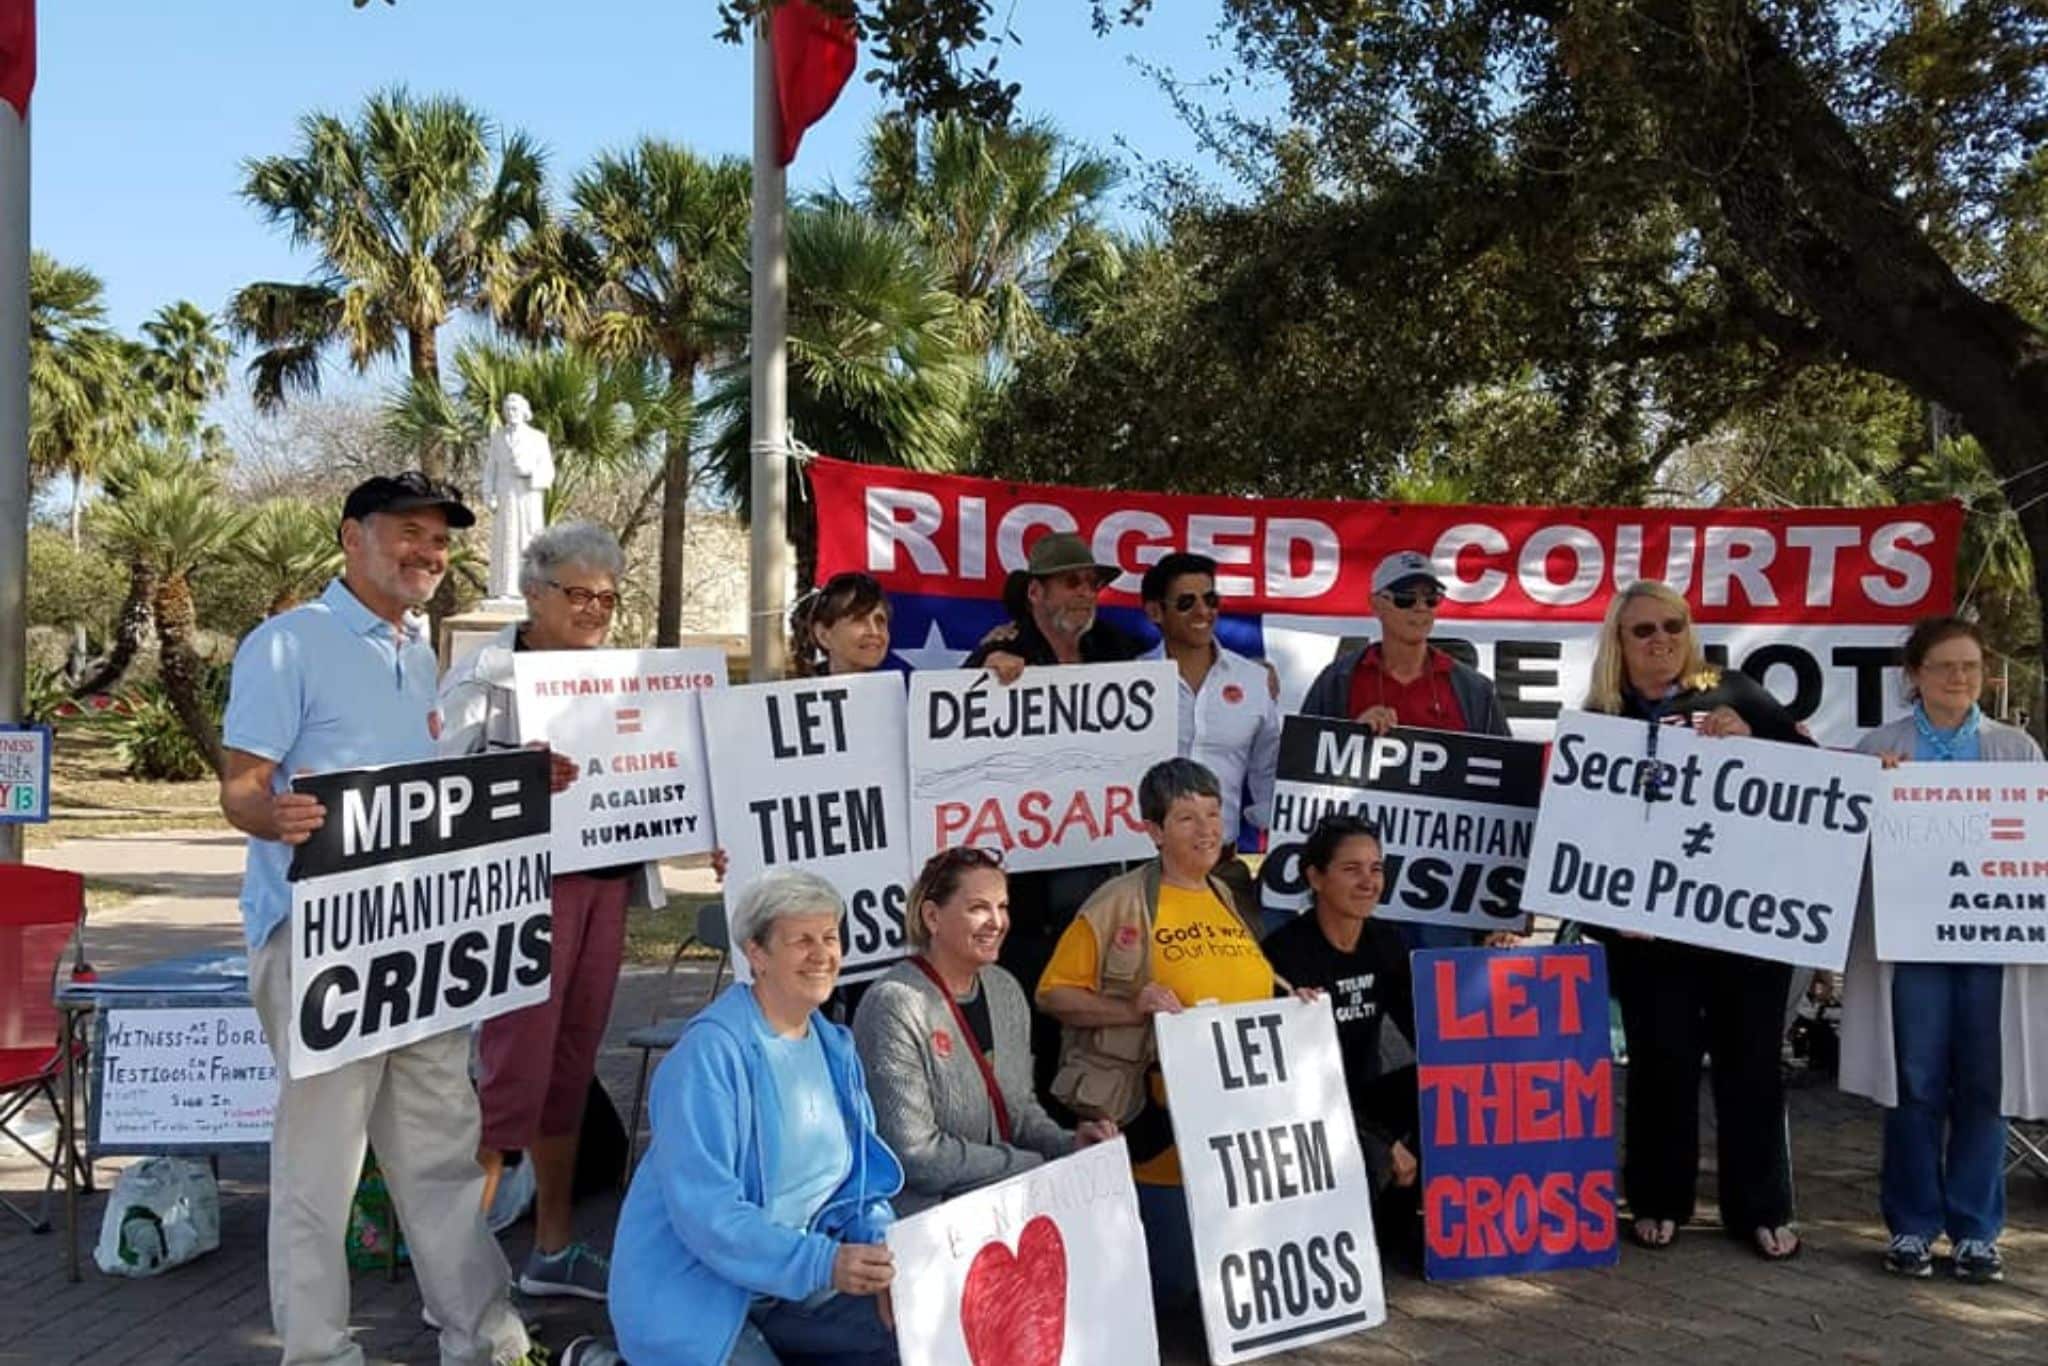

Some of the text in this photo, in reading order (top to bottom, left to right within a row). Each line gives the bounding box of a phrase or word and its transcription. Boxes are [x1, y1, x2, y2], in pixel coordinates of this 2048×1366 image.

[865, 486, 1936, 608] RIGGED COURTS
[535, 674, 715, 696] REMAIN IN MEXICO
[929, 672, 1156, 739] DÉJENLOS
[765, 689, 848, 759] LET
[1315, 731, 1448, 787] MPP
[15, 786, 34, 811] 13
[587, 751, 679, 776] A CRIME
[589, 784, 686, 811] AGAINST
[1552, 733, 1873, 835] Secret Courts
[1893, 787, 1991, 803] REMAIN
[2002, 788, 2026, 803] IN
[342, 775, 473, 857] MPP
[581, 816, 698, 847] HUMANITY
[750, 786, 888, 865] THEM
[936, 785, 1151, 851] PASAR
[304, 851, 551, 958] HUMANITARIAN
[1260, 843, 1527, 918] CISIS
[1549, 842, 1833, 944] Due Process
[1948, 861, 2048, 877] A CRIM
[1949, 893, 2046, 910] AGAIN
[1936, 924, 2046, 942] HUMAN
[300, 913, 551, 1051] CRISIS
[1434, 955, 1592, 1040] LET
[104, 1023, 183, 1047] WITNESS
[1211, 1013, 1287, 1091] LET
[1418, 1058, 1613, 1146] THEM
[1209, 1120, 1337, 1209] THEM
[1425, 1170, 1618, 1259] CROSS
[1220, 1230, 1364, 1331] CROSS
